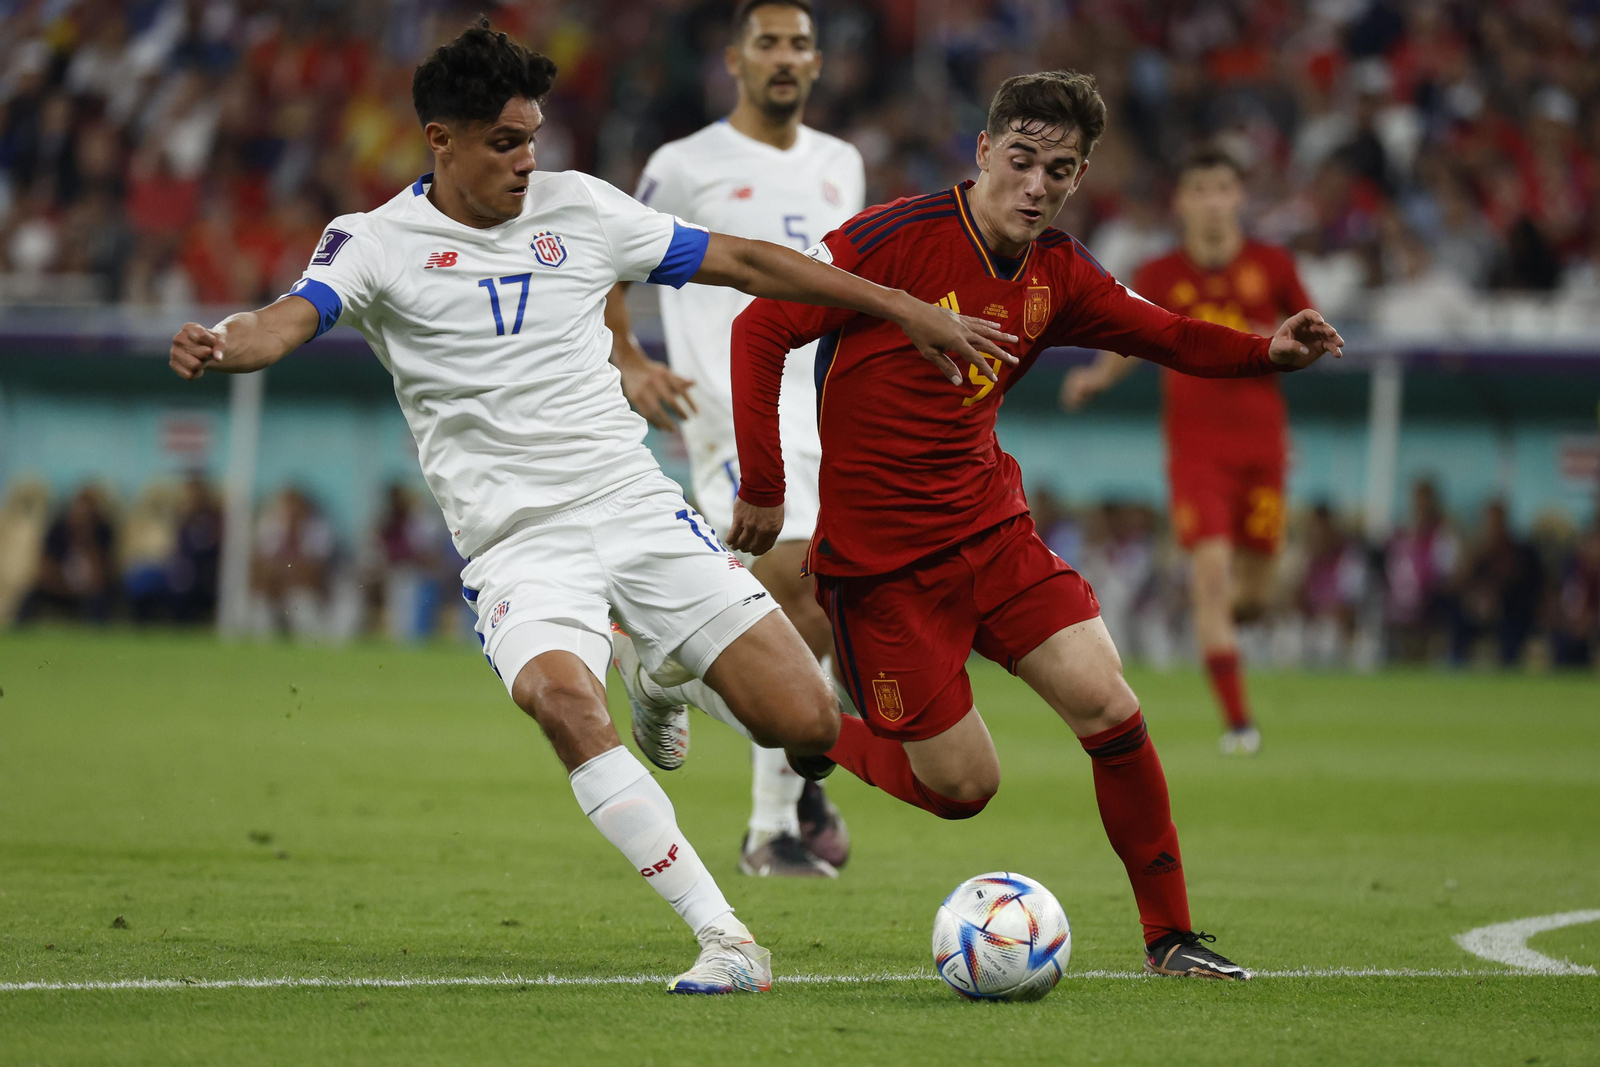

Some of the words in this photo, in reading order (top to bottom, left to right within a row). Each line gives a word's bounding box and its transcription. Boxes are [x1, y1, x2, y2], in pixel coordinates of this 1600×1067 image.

[536, 237, 561, 262] CR
[783, 215, 811, 251] 5
[478, 272, 533, 336] 17
[961, 350, 1002, 407] 9
[640, 843, 679, 877] CRF
